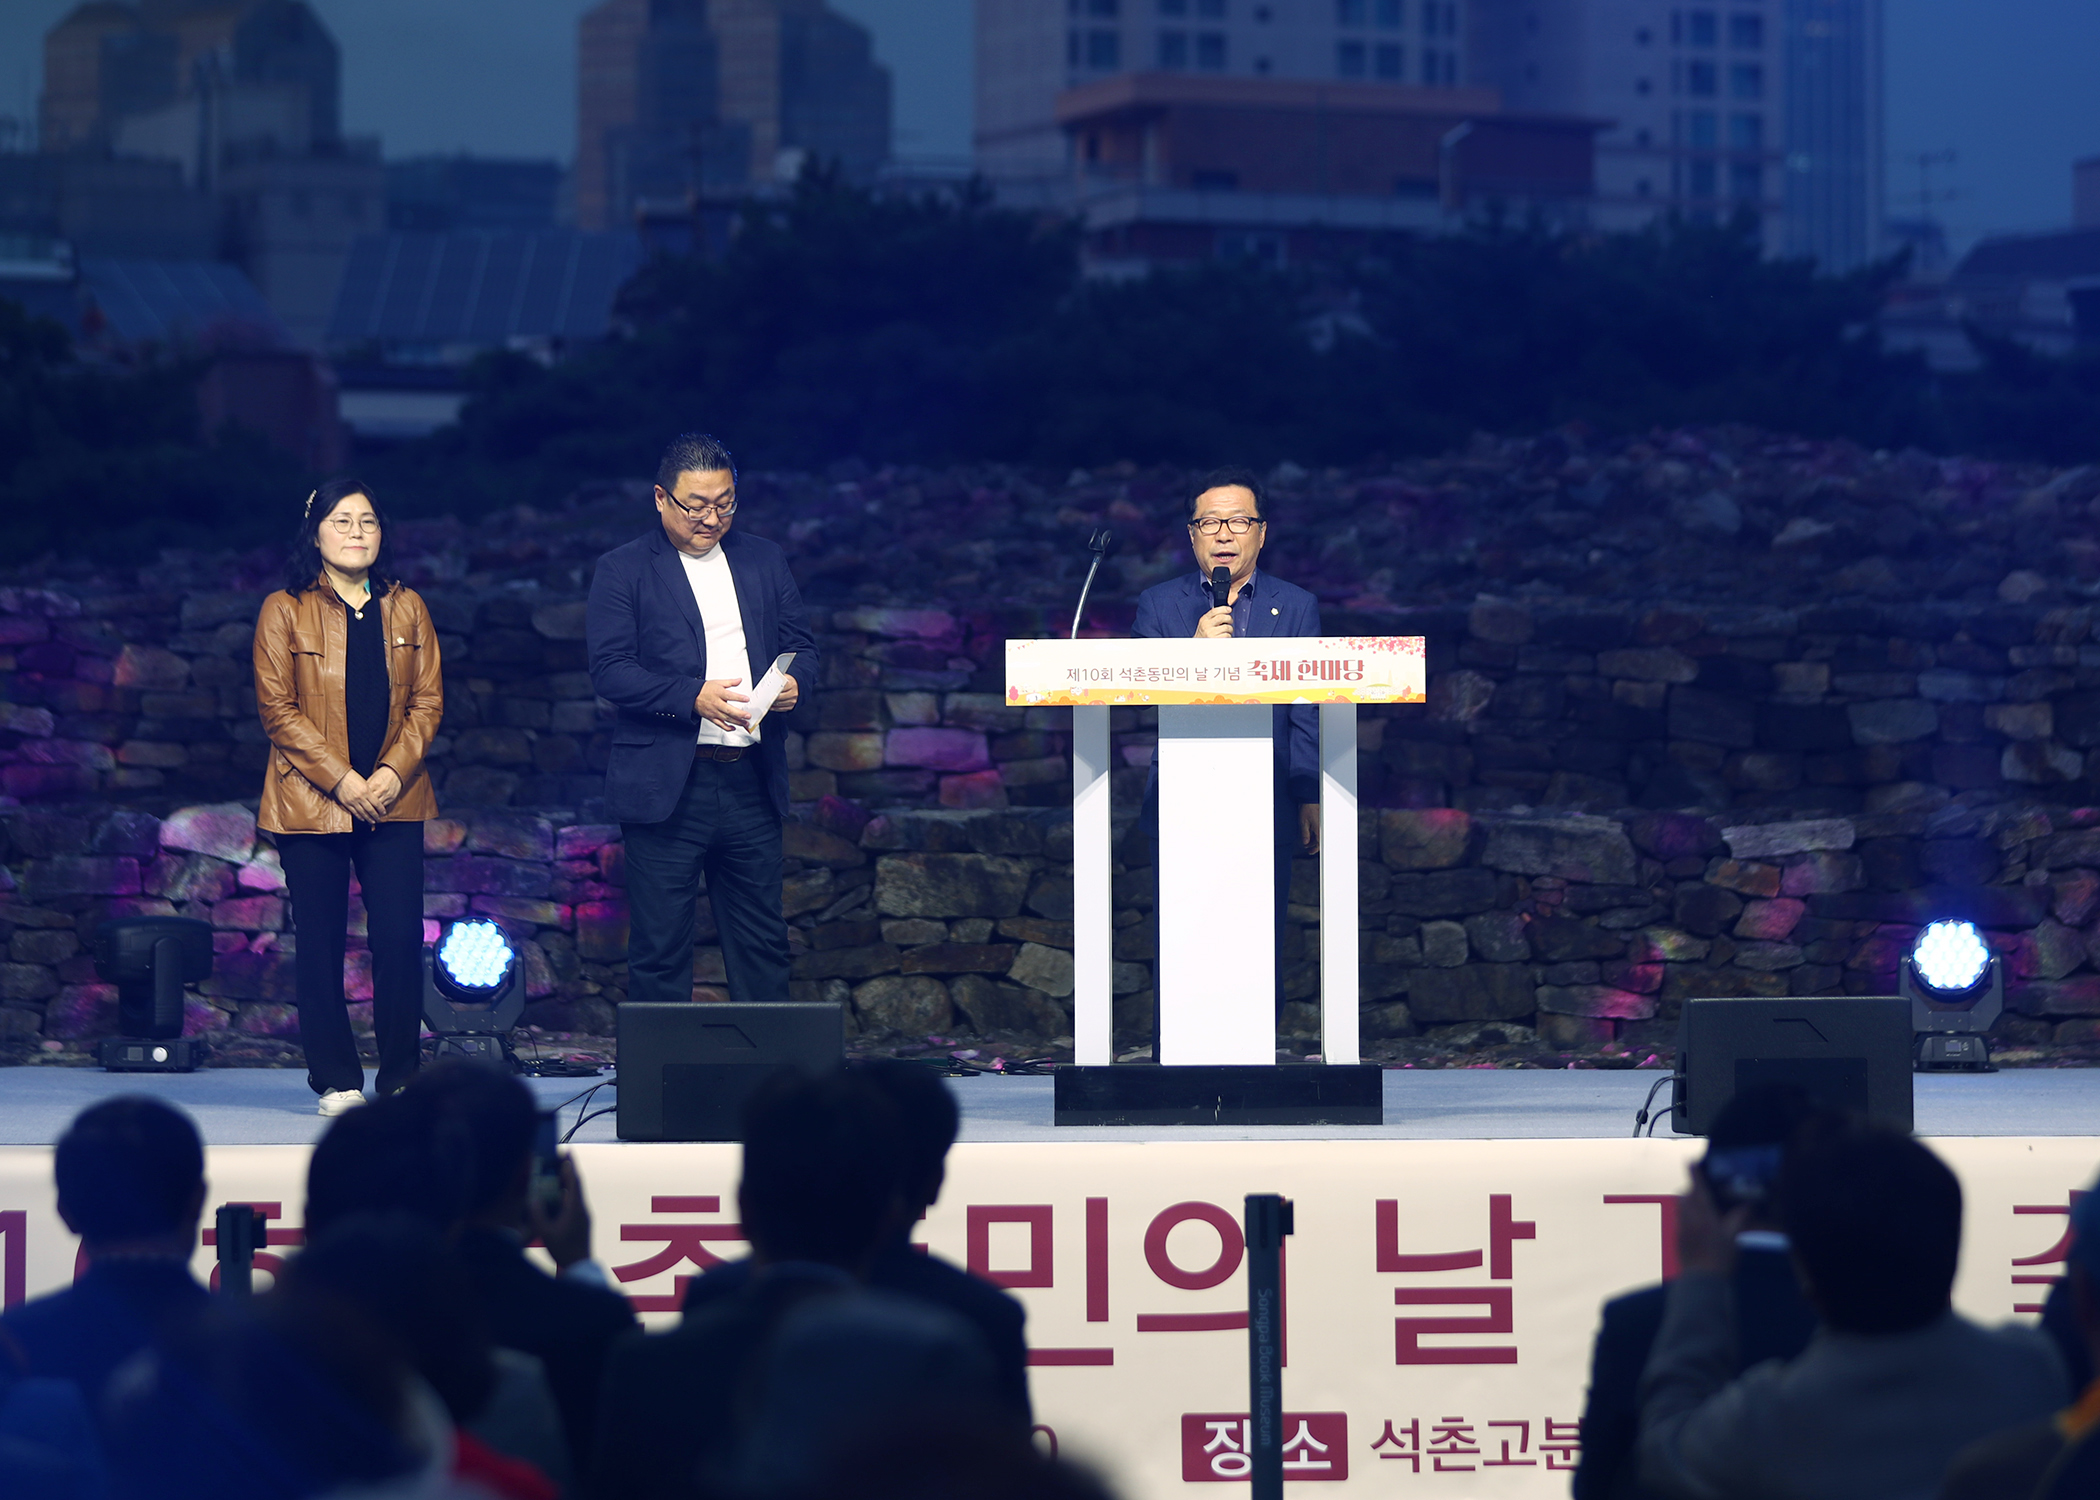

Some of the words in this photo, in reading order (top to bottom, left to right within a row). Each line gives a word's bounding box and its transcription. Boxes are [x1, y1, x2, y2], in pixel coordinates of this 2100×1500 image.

[1066, 667, 1113, 682] 제10회
[1119, 667, 1189, 682] 석촌동민의
[1195, 667, 1208, 682] 날
[1214, 667, 1240, 681] 기념
[1247, 660, 1291, 681] 축제
[1298, 659, 1365, 681] 한마당
[1376, 1193, 1536, 1365] 날
[1255, 1288, 1273, 1343] Songpa
[1259, 1345, 1273, 1383] Book
[1260, 1385, 1274, 1447] Museum
[1203, 1418, 1332, 1477] 장소
